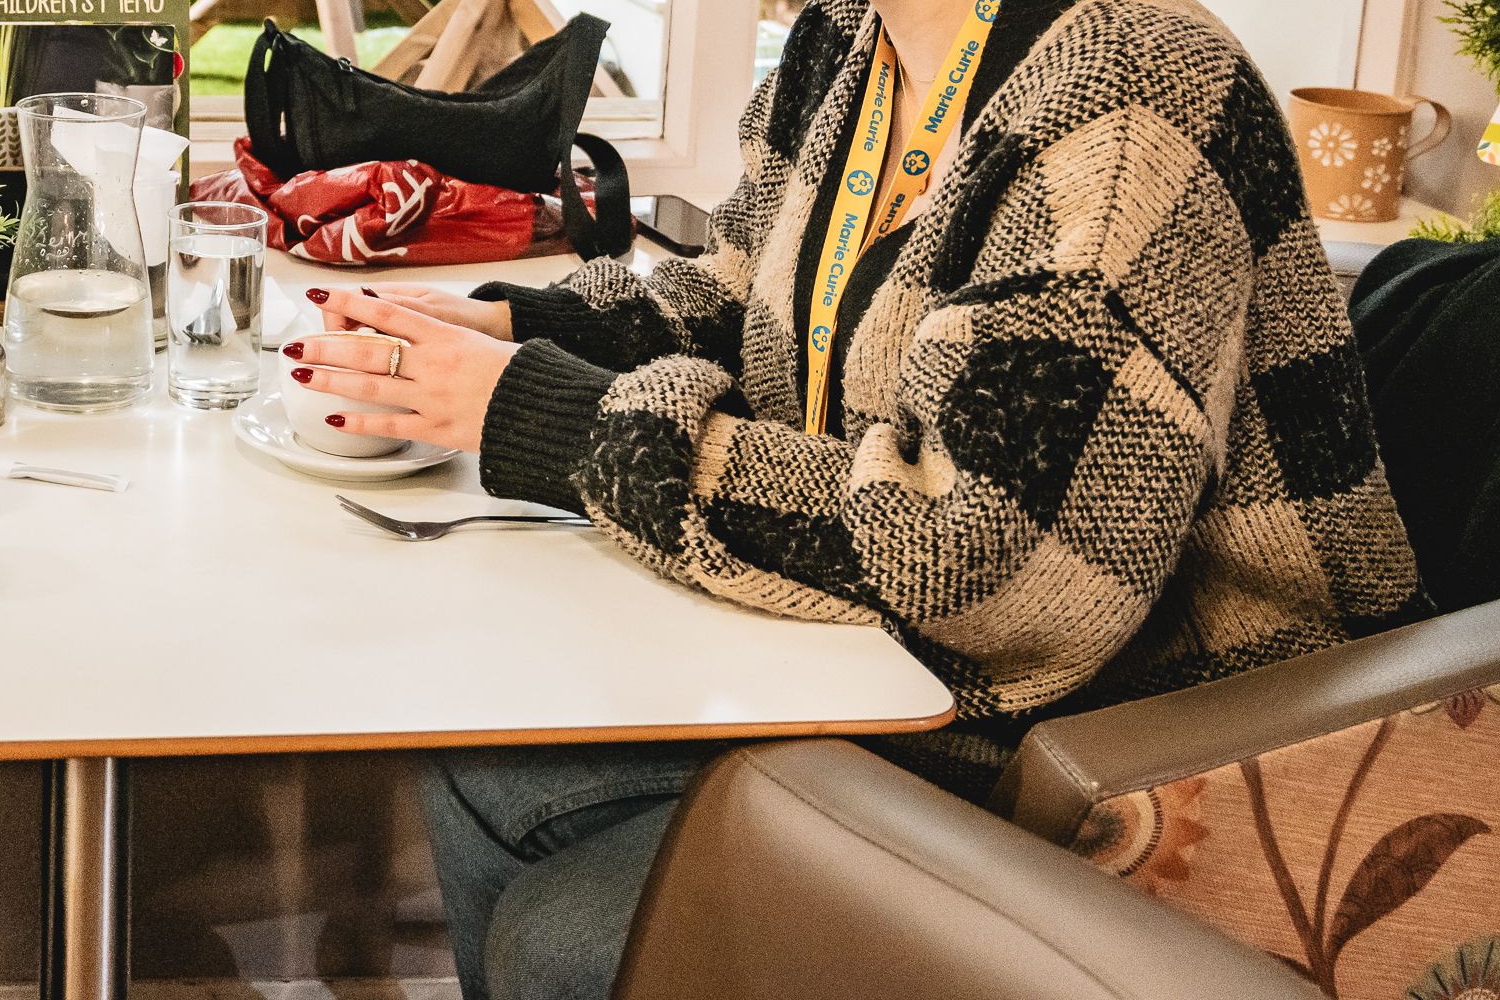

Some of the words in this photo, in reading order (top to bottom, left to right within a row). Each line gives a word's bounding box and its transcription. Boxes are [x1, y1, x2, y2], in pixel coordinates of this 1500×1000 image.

[874, 61, 890, 108] Marie
[924, 86, 957, 133] Marie
[949, 40, 979, 83] Curie
[864, 110, 884, 152] Curie
[879, 193, 905, 234] Curie
[834, 213, 858, 261] Marie
[823, 263, 844, 306] Curie
